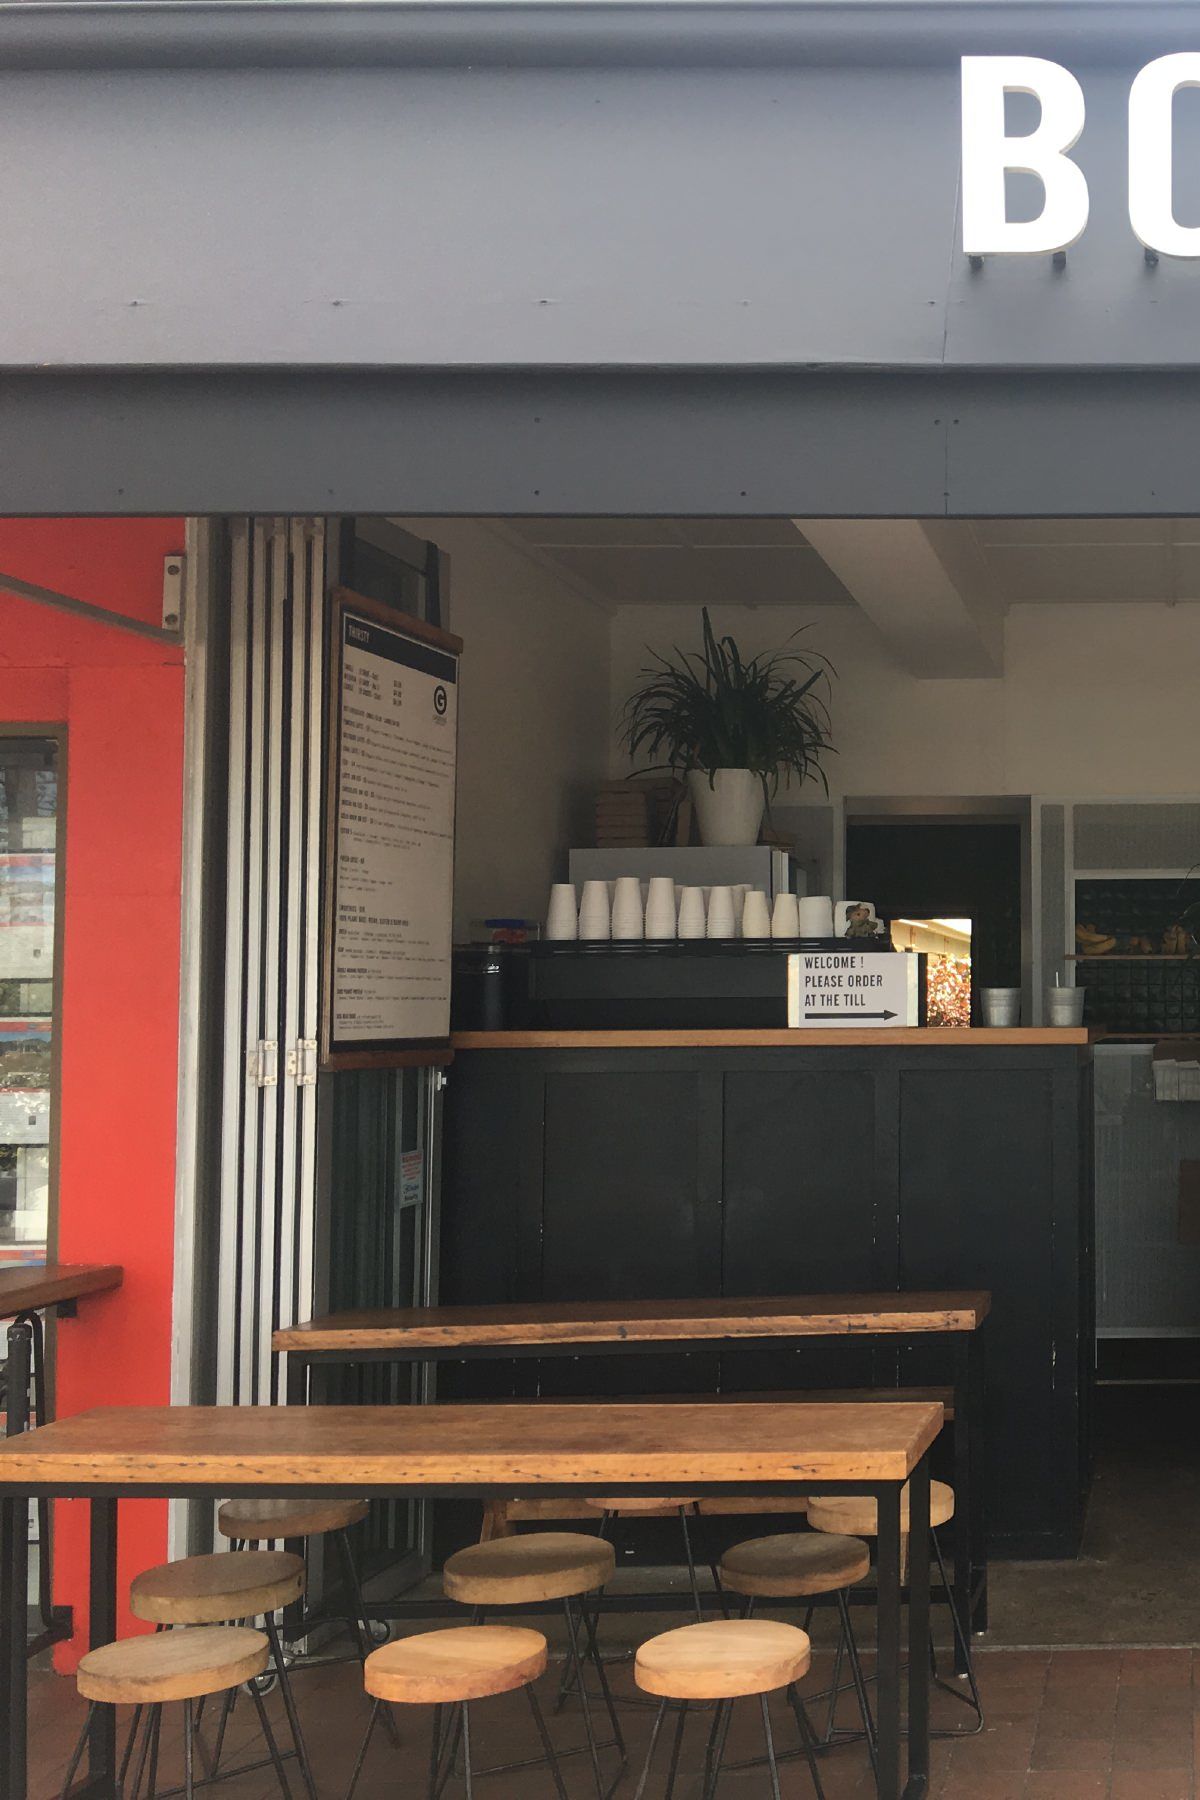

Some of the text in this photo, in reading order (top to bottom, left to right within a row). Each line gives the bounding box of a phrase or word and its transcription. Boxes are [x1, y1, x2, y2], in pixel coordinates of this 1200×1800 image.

[804, 956, 856, 969] WELCOME
[805, 974, 883, 988] PLEASE ORDER
[804, 994, 866, 1006] AT THE TILL
